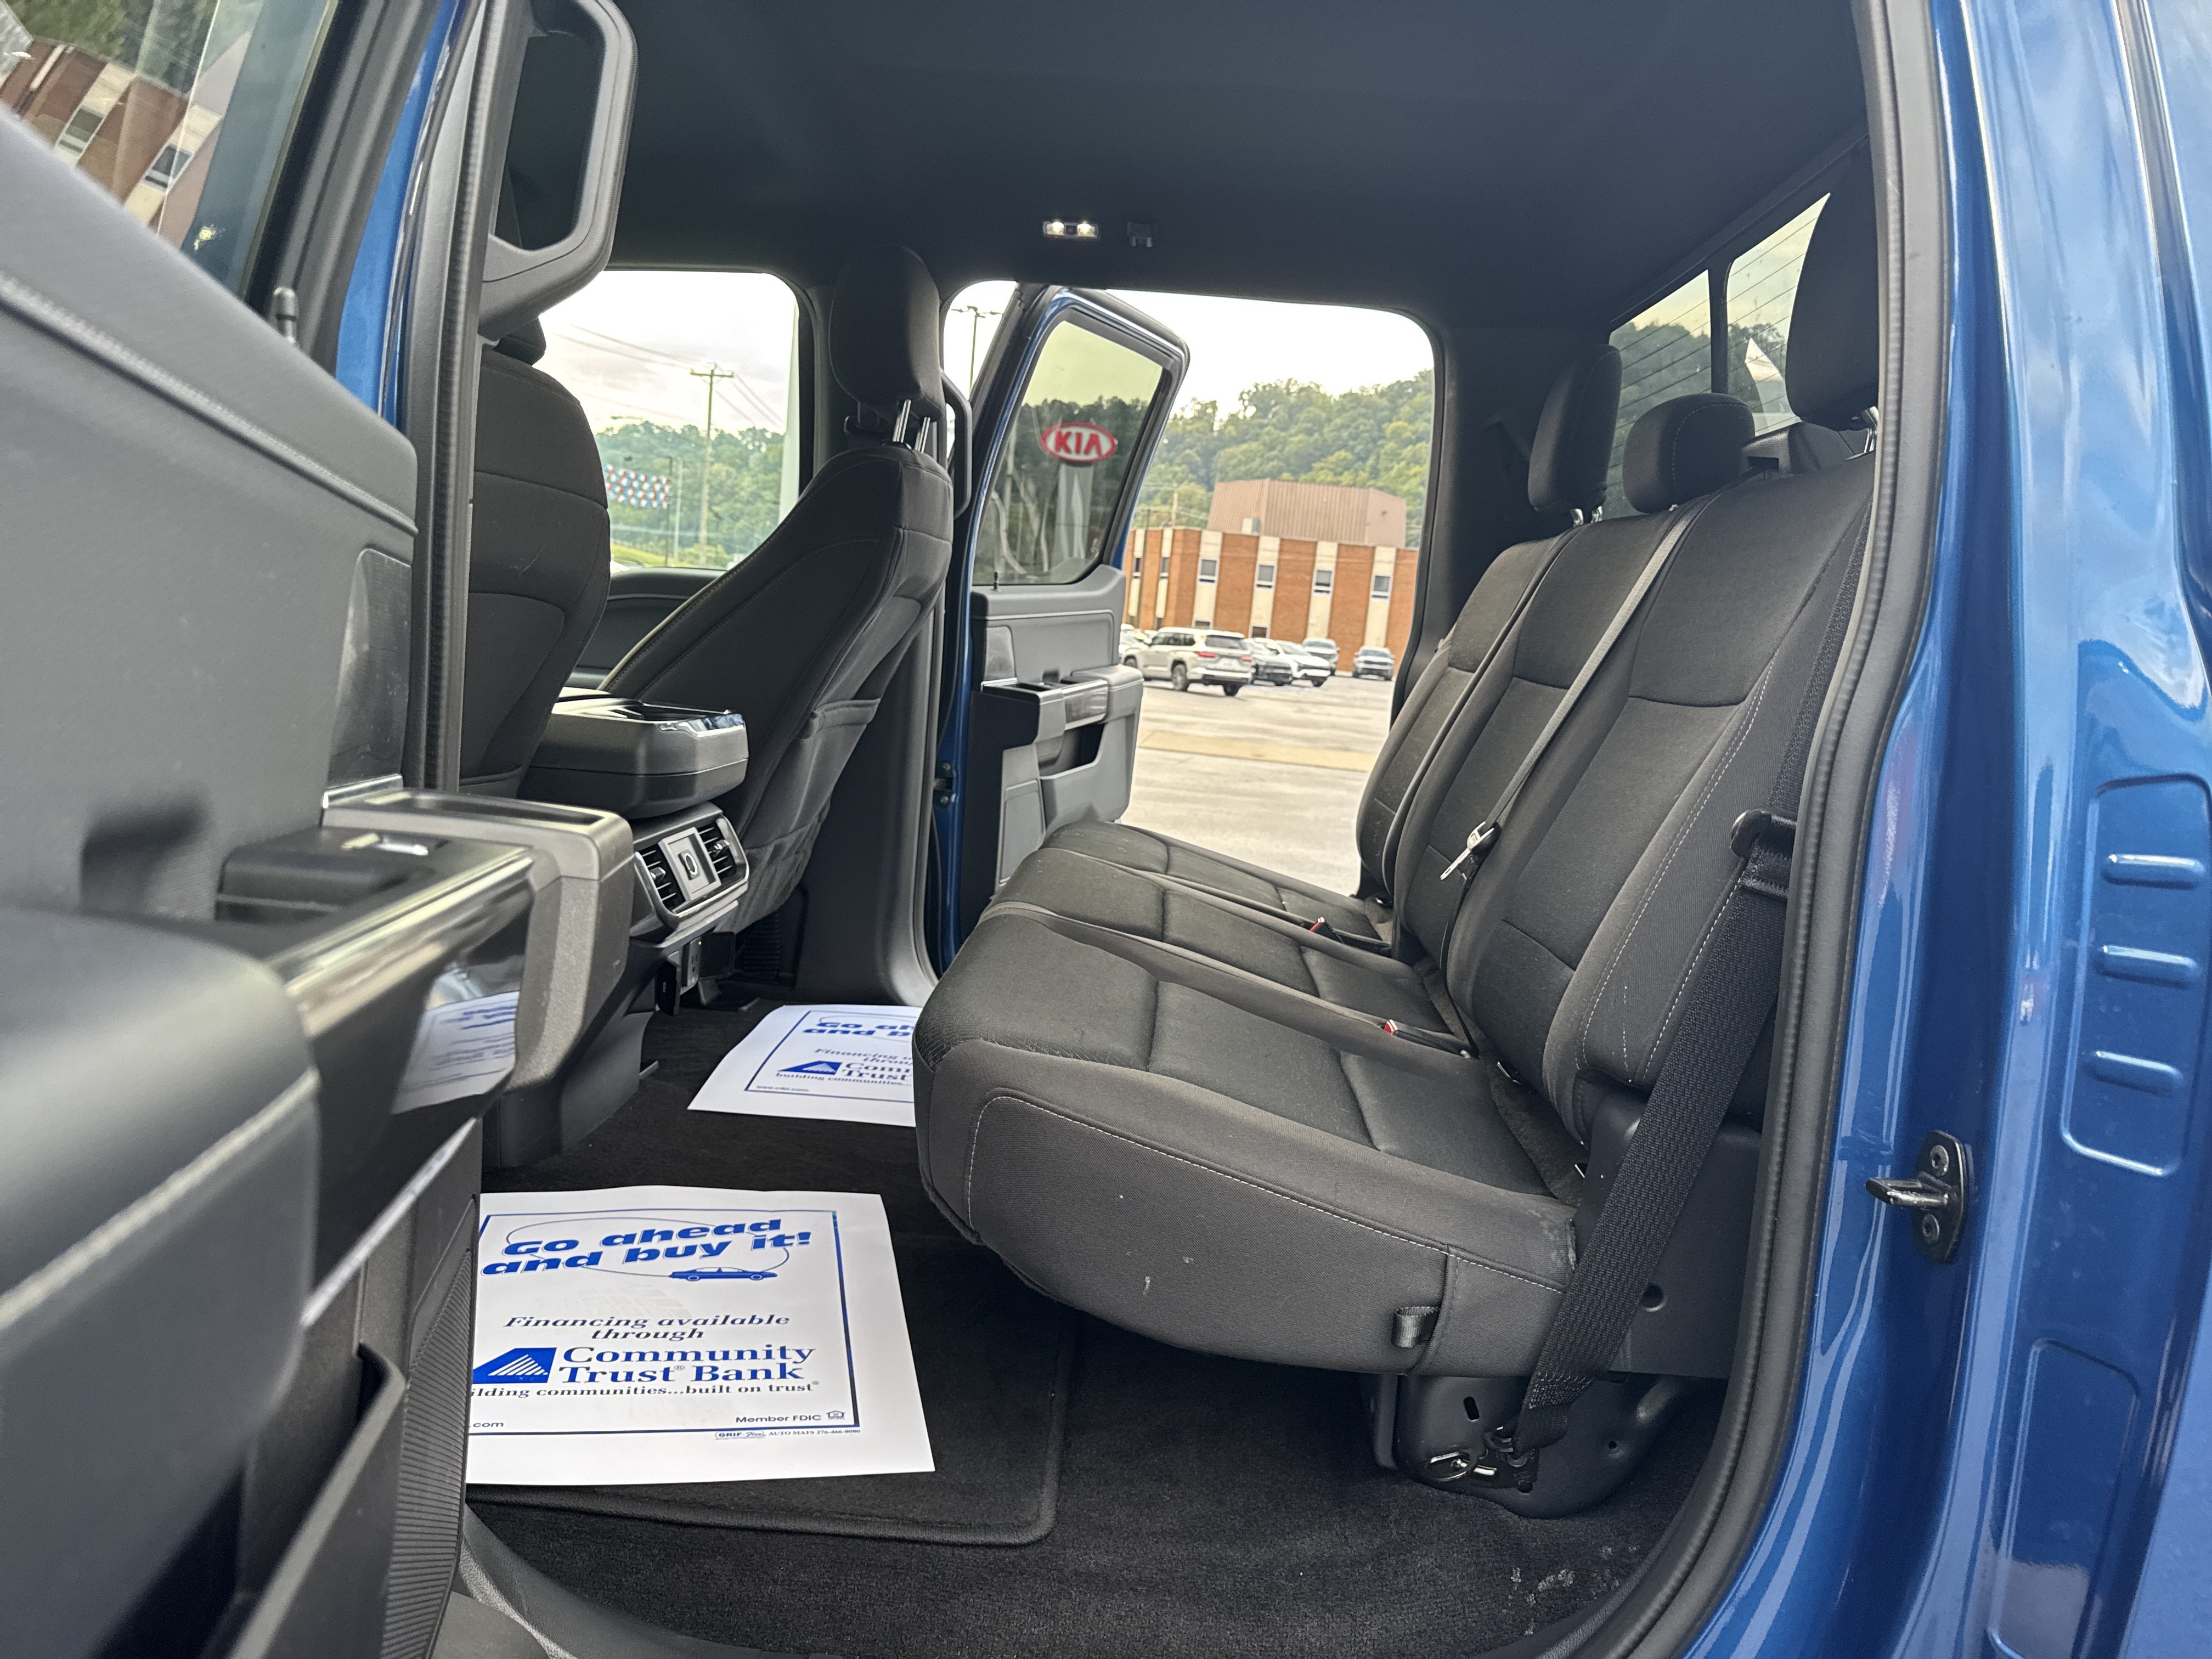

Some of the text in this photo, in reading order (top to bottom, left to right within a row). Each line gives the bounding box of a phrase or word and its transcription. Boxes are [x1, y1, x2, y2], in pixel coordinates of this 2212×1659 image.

[1054, 430, 1103, 456] KIA
[501, 1218, 782, 1255] Go ahead
[481, 1232, 811, 1275] and buy it!
[503, 1314, 790, 1329] Financing available
[591, 1328, 704, 1341] through
[563, 1344, 817, 1364] Community
[690, 1362, 805, 1382] Bank
[735, 1415, 789, 1423] Member
